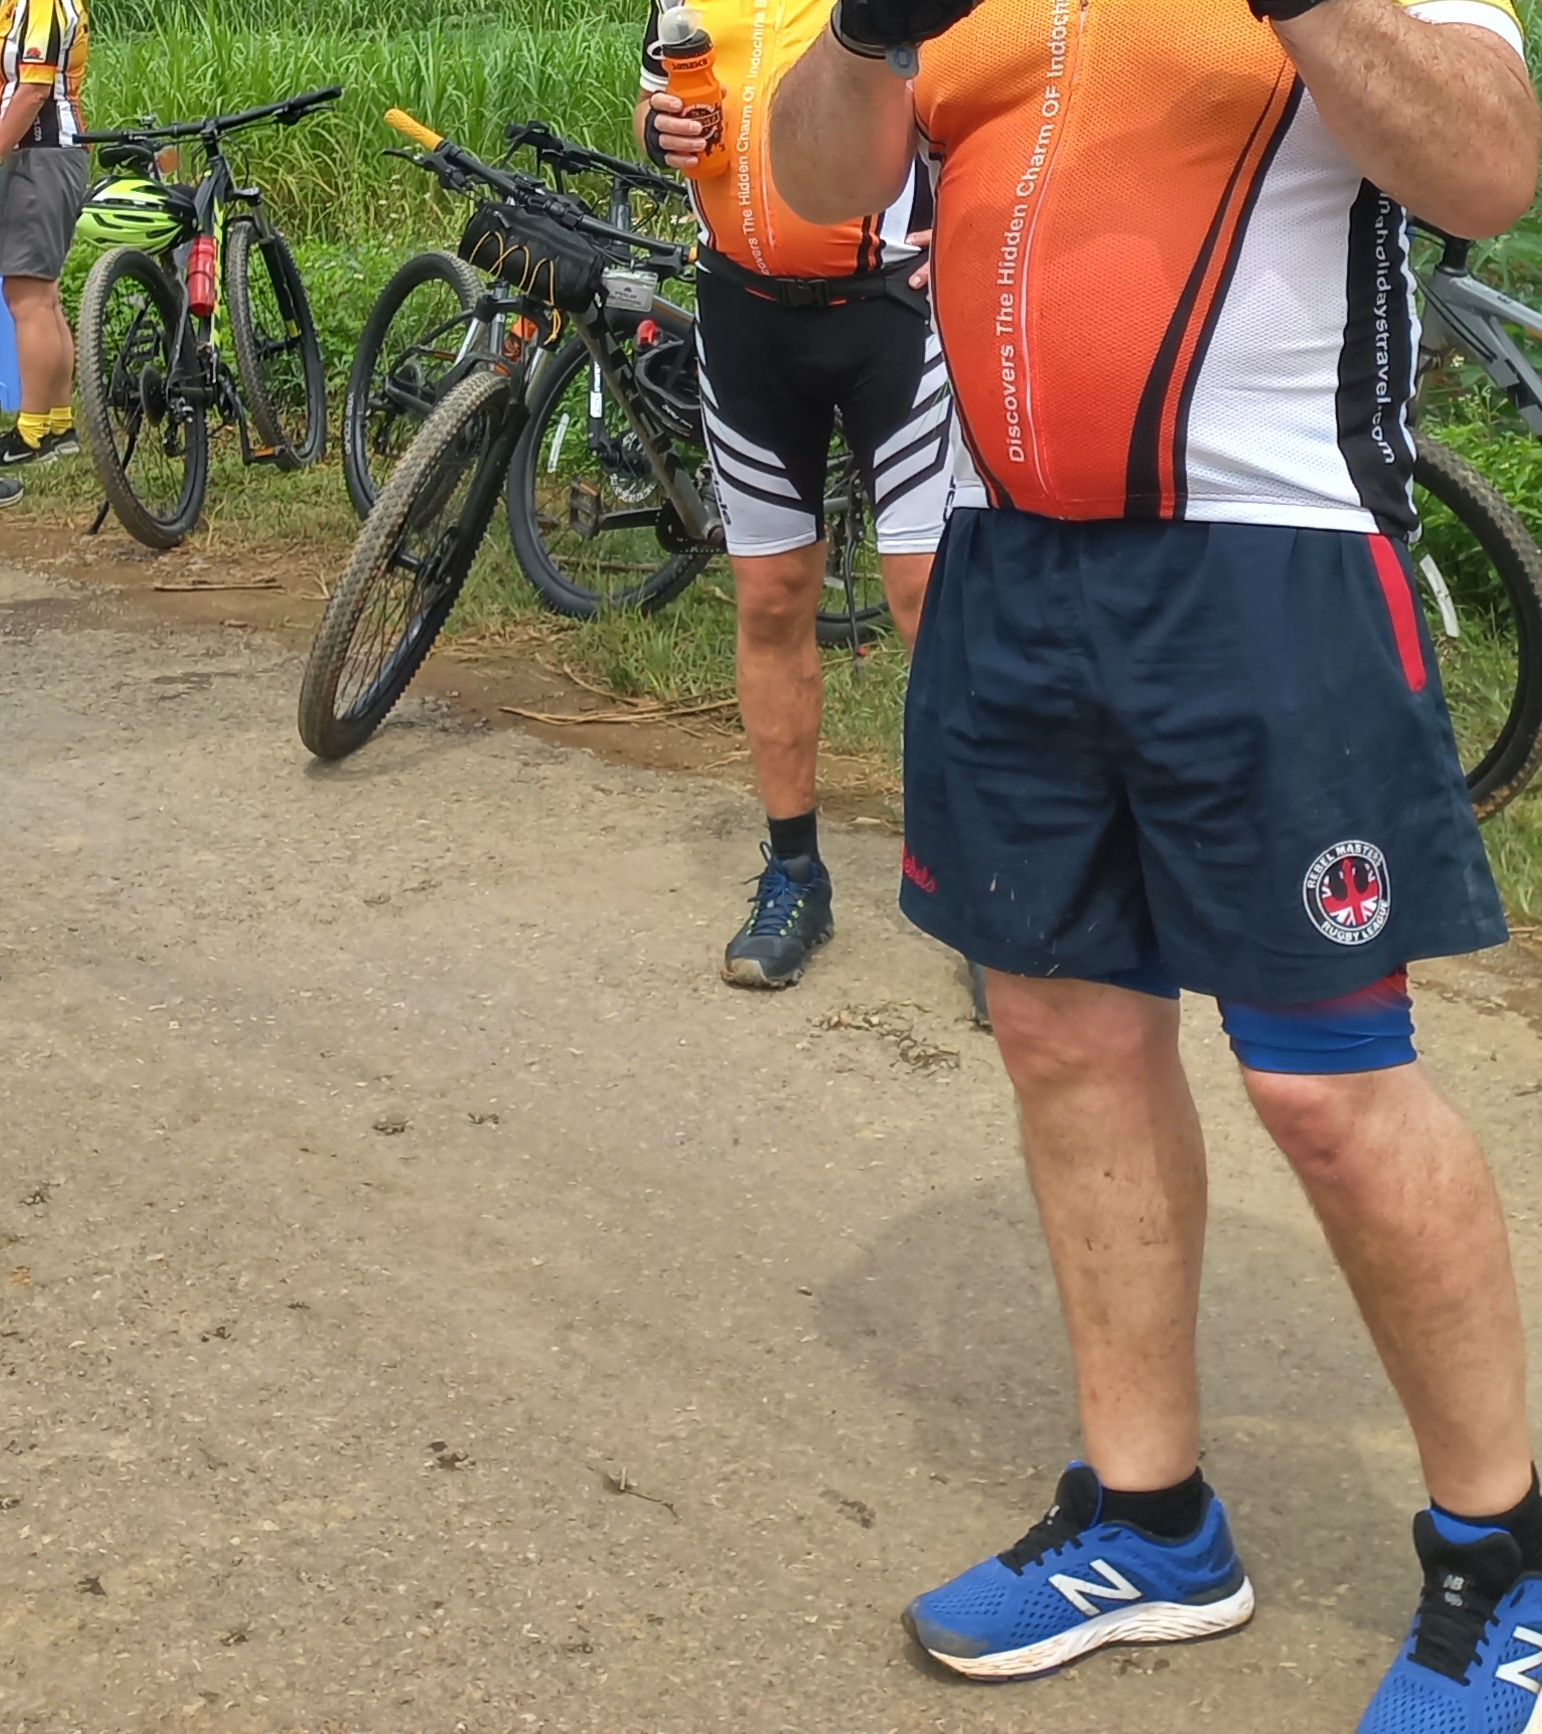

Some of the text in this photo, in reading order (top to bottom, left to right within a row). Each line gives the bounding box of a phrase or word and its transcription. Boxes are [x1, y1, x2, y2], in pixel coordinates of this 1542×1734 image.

[746, 11, 767, 79] Indochina
[735, 104, 753, 153] Charm
[735, 155, 751, 207] Hidden
[1016, 123, 1054, 198] Charm
[742, 209, 756, 236] The
[997, 203, 1029, 286] Hidden
[995, 292, 1015, 337] The
[1370, 191, 1397, 465] naholidaystravel.com
[996, 343, 1027, 464] Discovers
[1306, 843, 1383, 890] REBEL MASTERS
[1320, 899, 1390, 942] RUGBY LEAGUE
[1047, 1557, 1143, 1617] N
